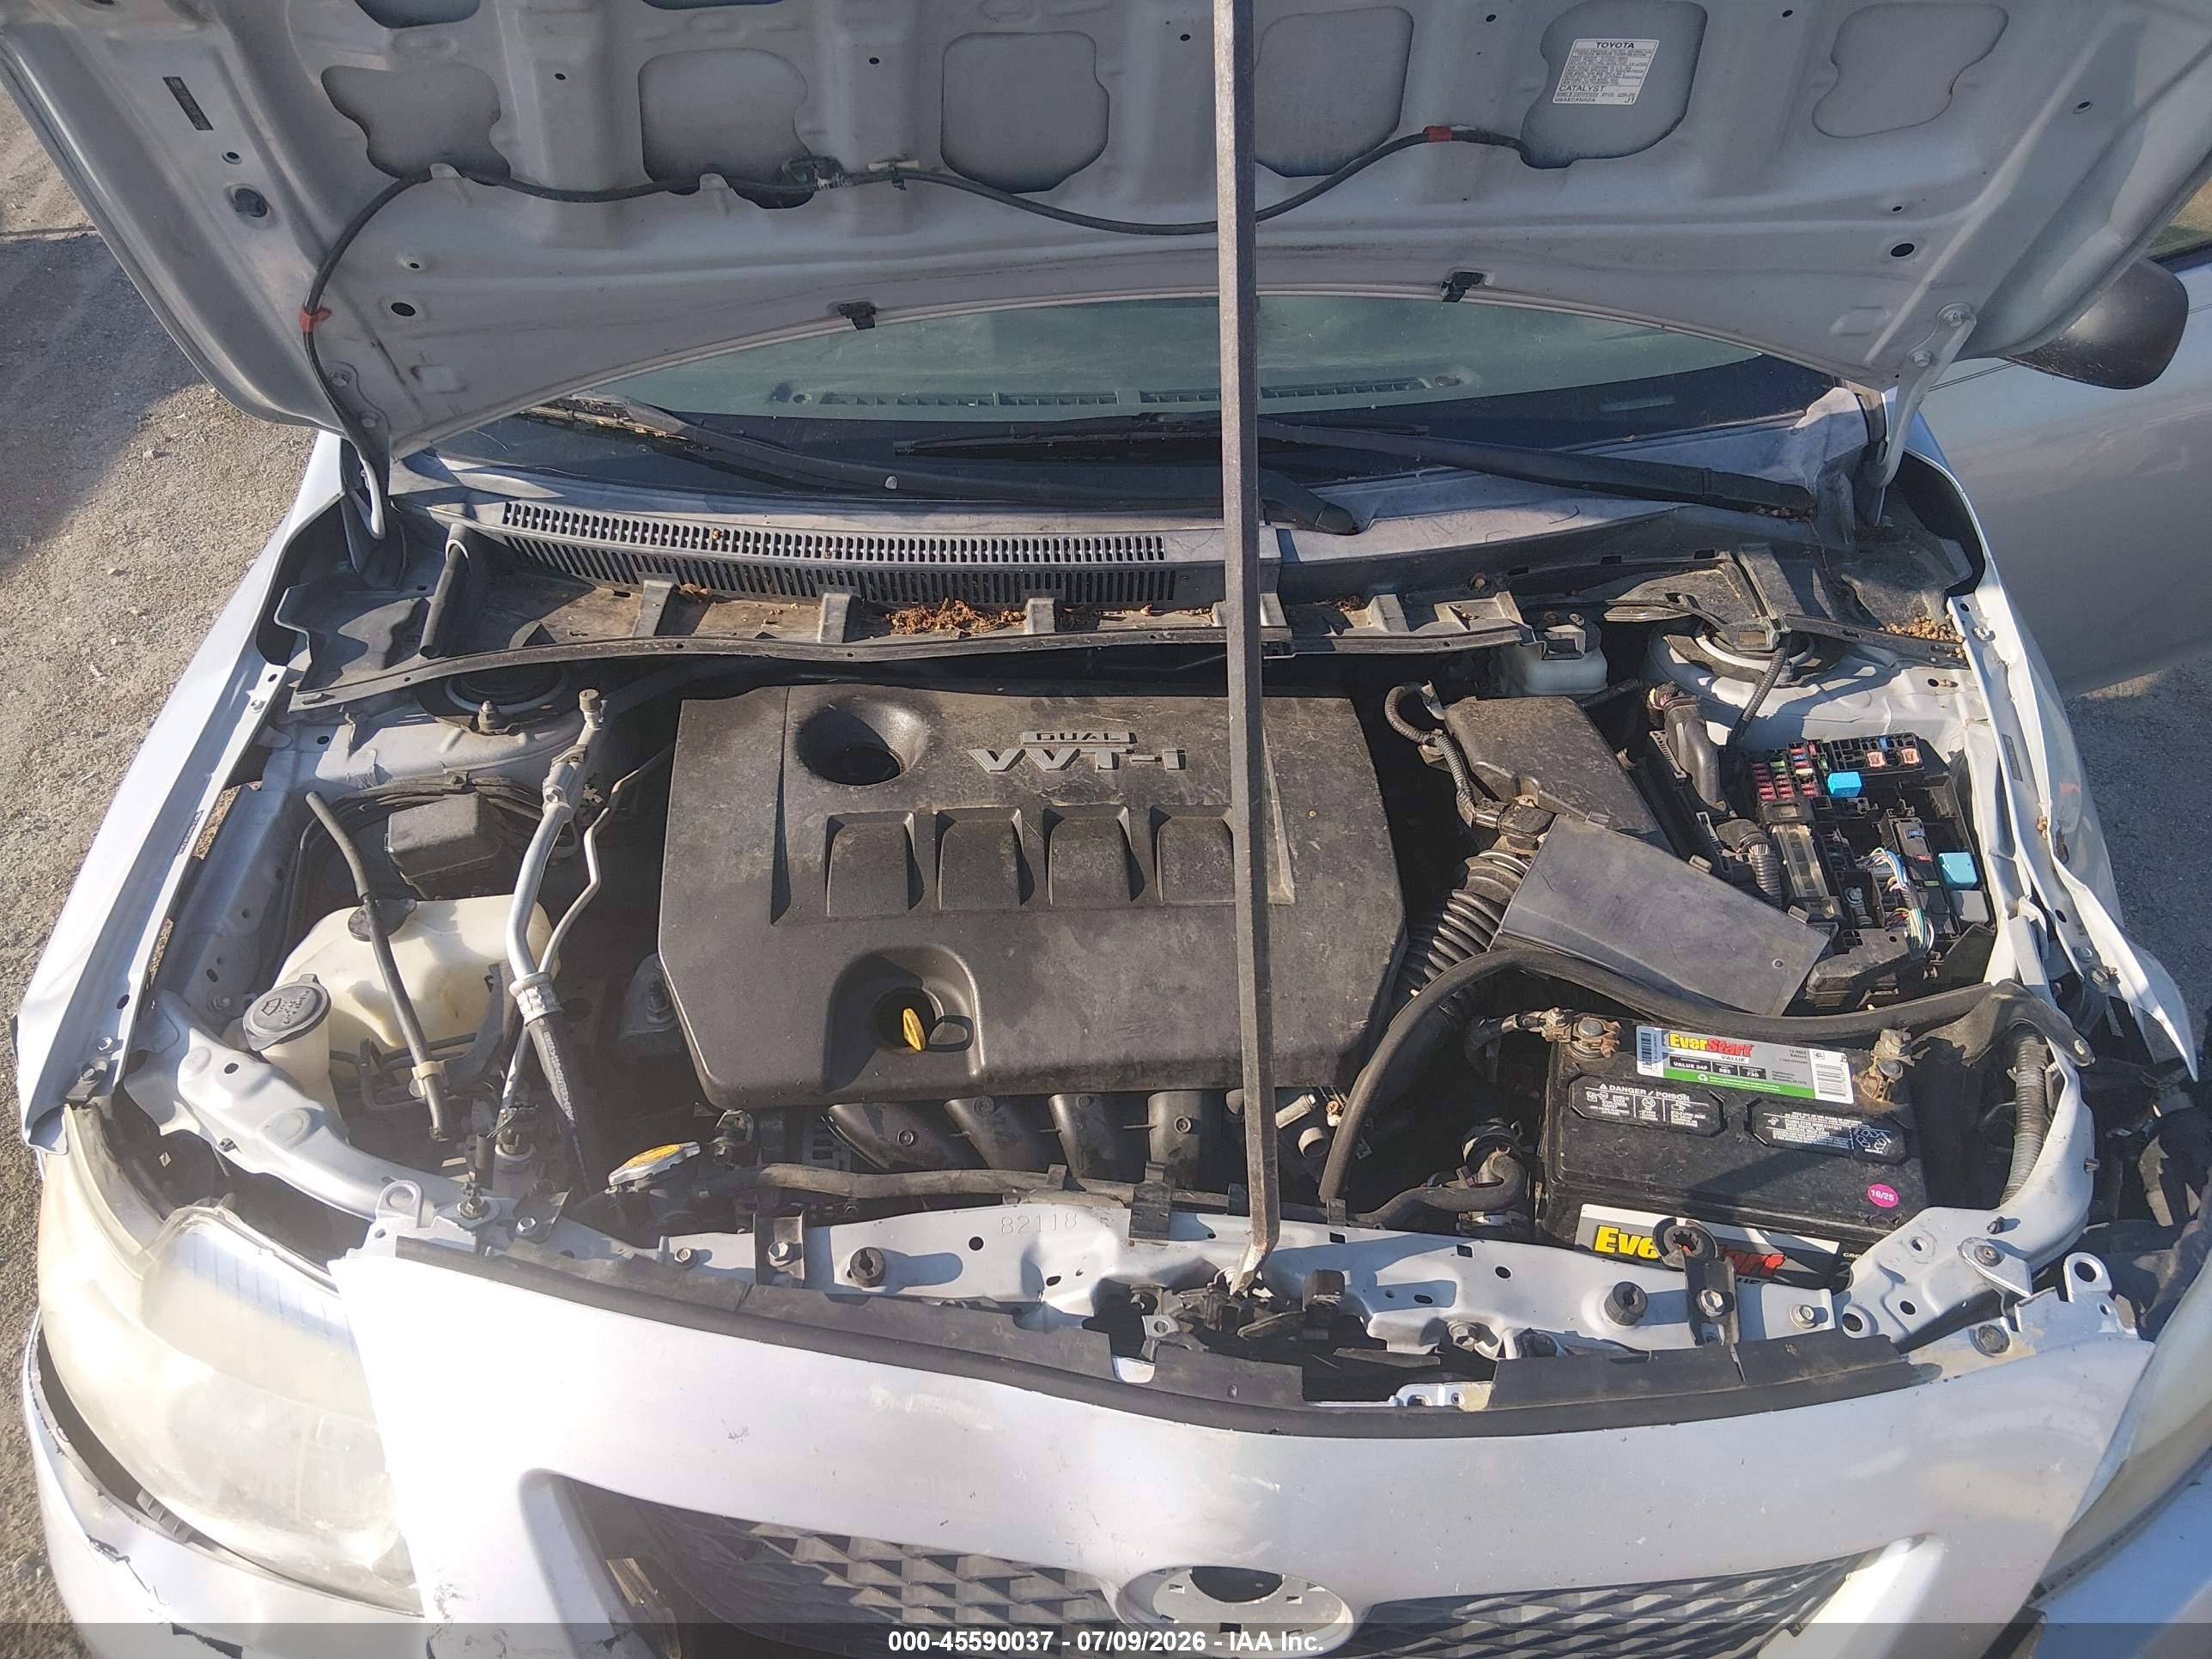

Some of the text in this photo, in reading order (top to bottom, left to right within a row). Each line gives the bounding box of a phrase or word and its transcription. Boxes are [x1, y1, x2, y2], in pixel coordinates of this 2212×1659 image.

[1036, 732, 1121, 741] DUAL
[1668, 1032, 1754, 1057] EverStart
[1608, 1084, 1647, 1096] DANGER
[1656, 1091, 1691, 1102] POISON
[1870, 1188, 1895, 1202] 10/25
